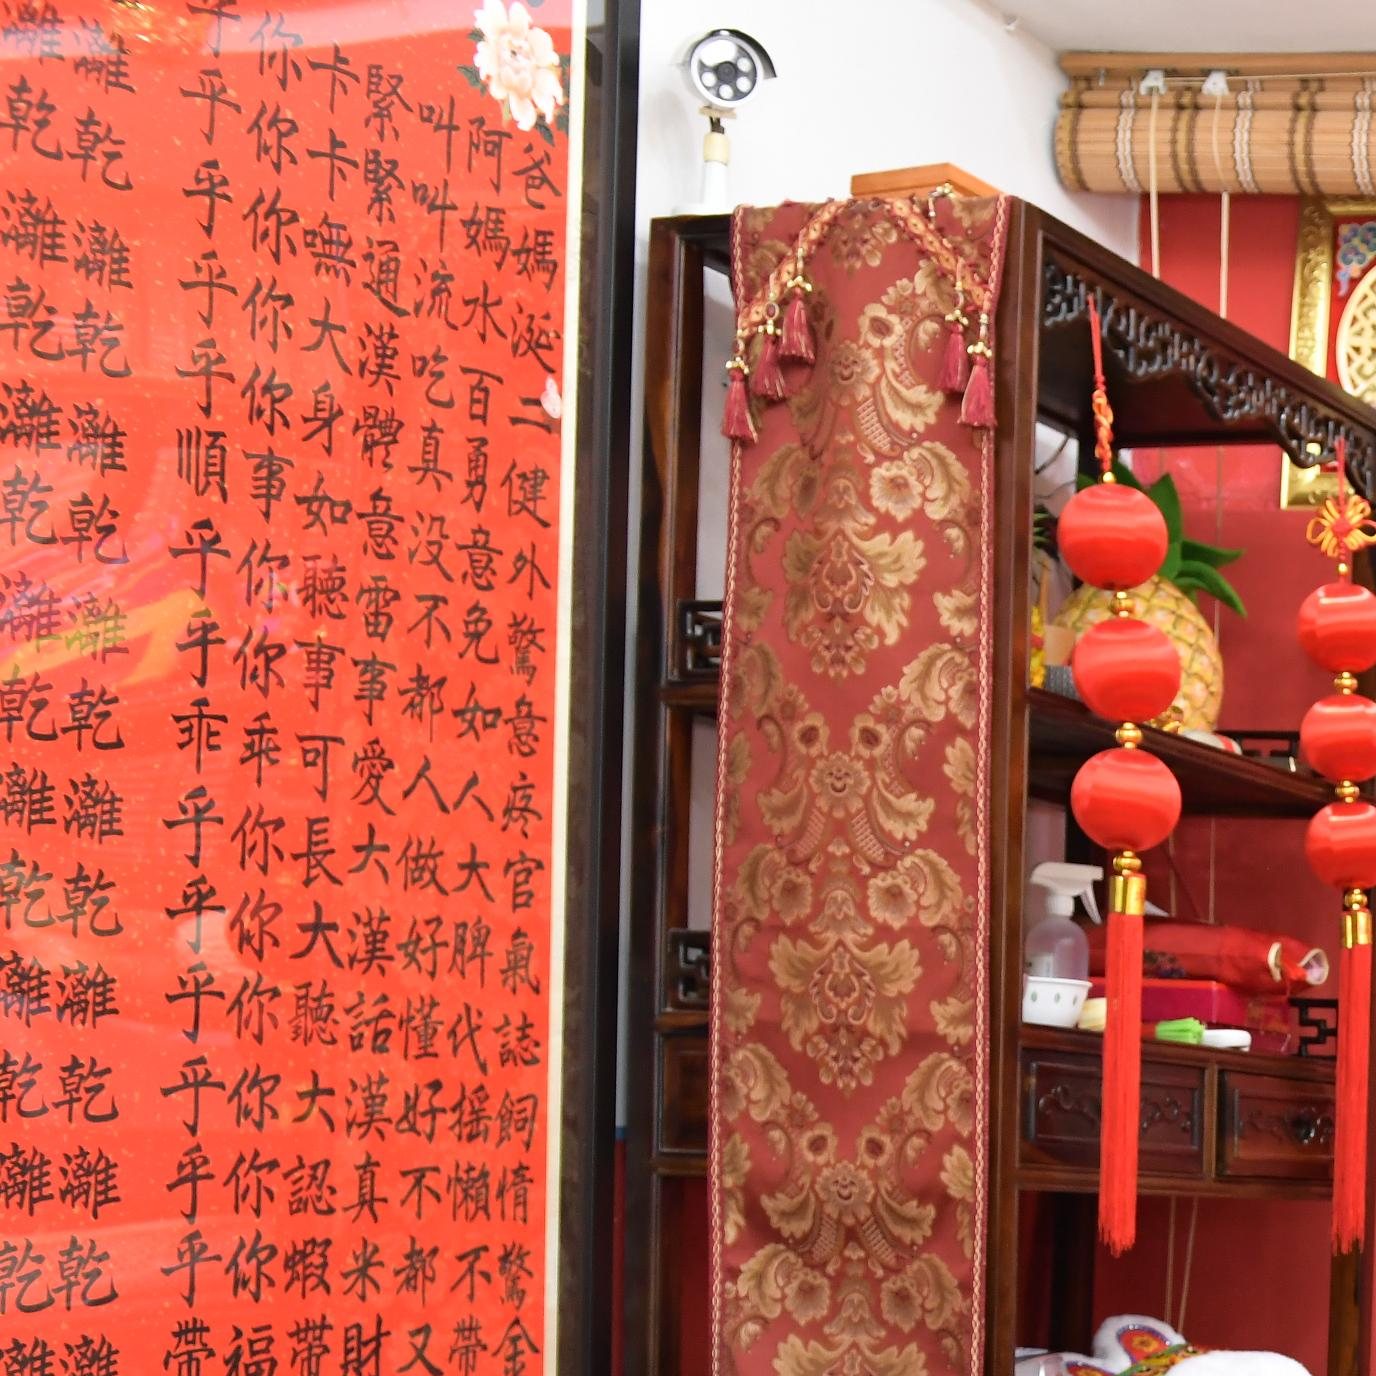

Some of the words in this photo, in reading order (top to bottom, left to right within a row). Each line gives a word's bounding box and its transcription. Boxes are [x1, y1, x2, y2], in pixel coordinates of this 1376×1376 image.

[179, 68, 557, 294] 乎你卡緊叫媽媽
[178, 251, 553, 434] 乎你大漢吃百二
[175, 338, 551, 528] 乎你身體真勇健
[168, 517, 546, 686] 乎你聽雷不免驚
[175, 608, 547, 757] 乎你事事都如意
[162, 785, 544, 913] 乎你長大做大官
[165, 874, 540, 995] 乎你大漢好脾氣
[165, 961, 540, 1077] 乎你聽話懂代誌
[161, 1229, 533, 1311] 乎你蝦米都不驚
